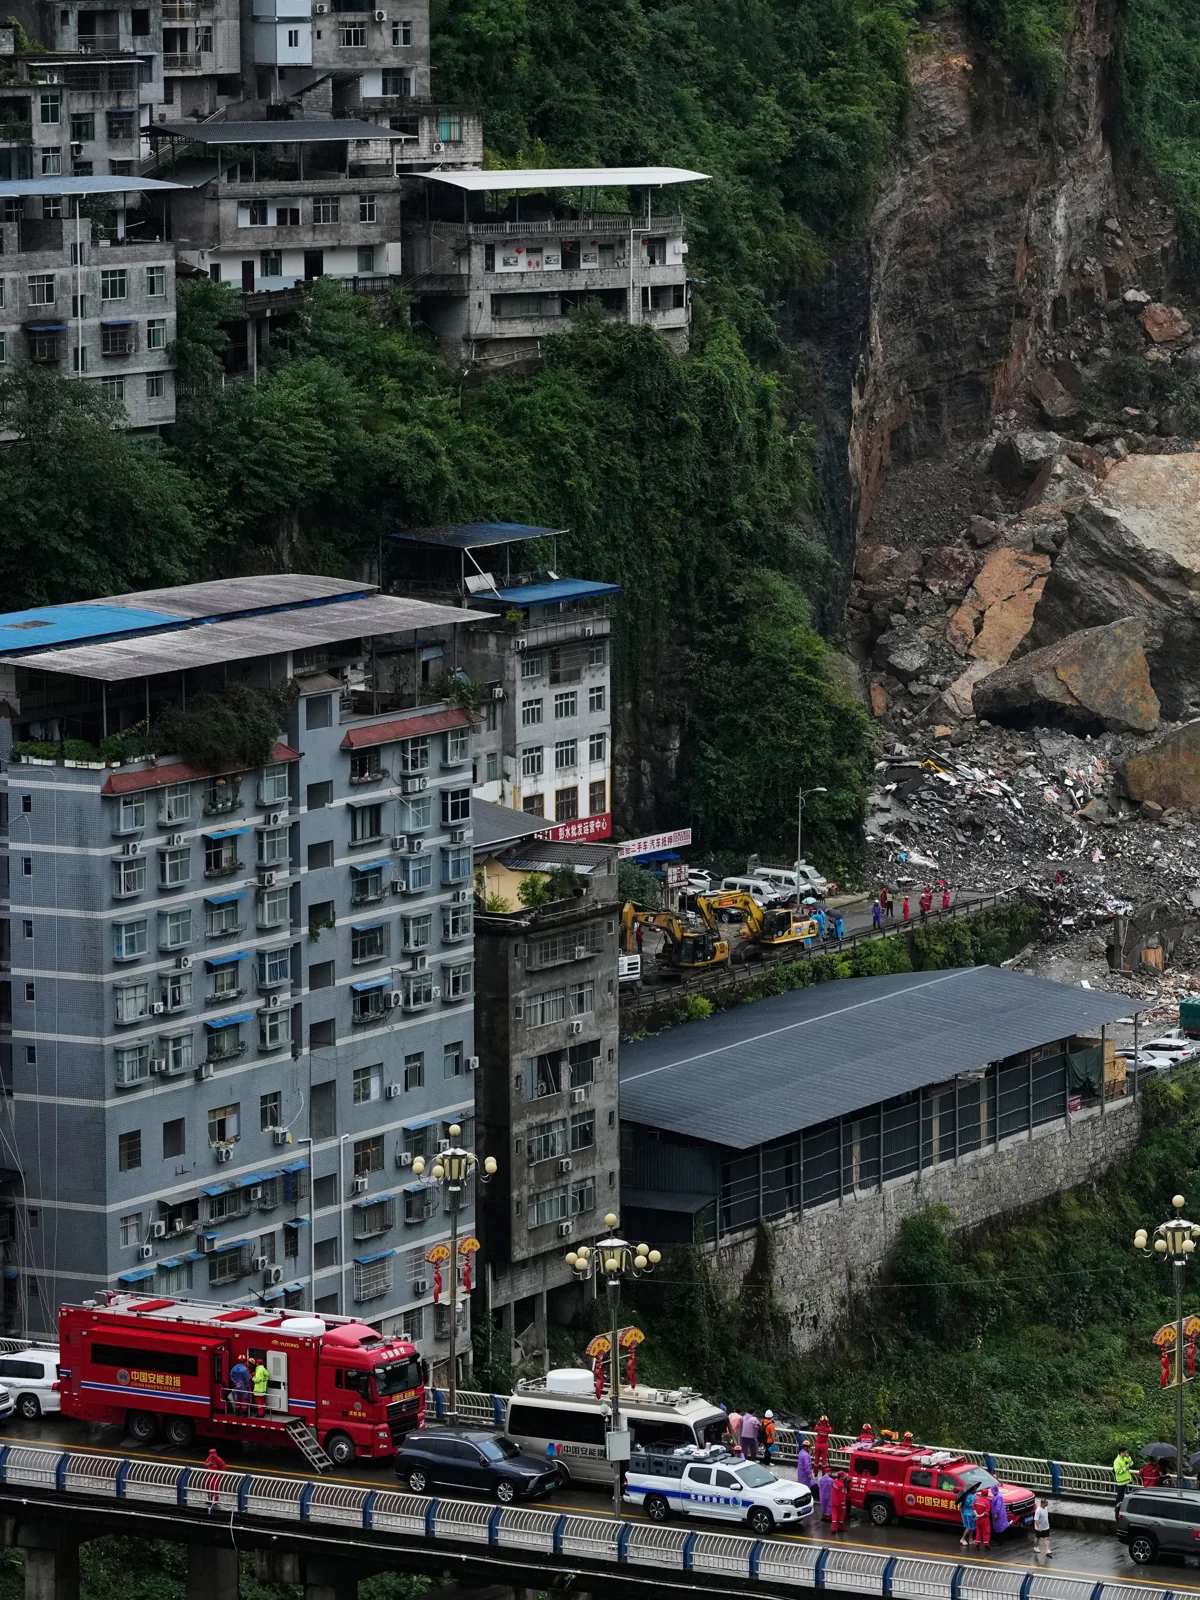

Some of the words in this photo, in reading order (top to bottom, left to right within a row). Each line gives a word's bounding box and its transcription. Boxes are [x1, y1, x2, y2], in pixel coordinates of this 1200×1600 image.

[558, 818, 607, 840] 彭水批发运营中心
[279, 1341, 300, 1349] YUTONG
[131, 1371, 181, 1386] 中国安能救援
[916, 1495, 961, 1511] 中国安能救
